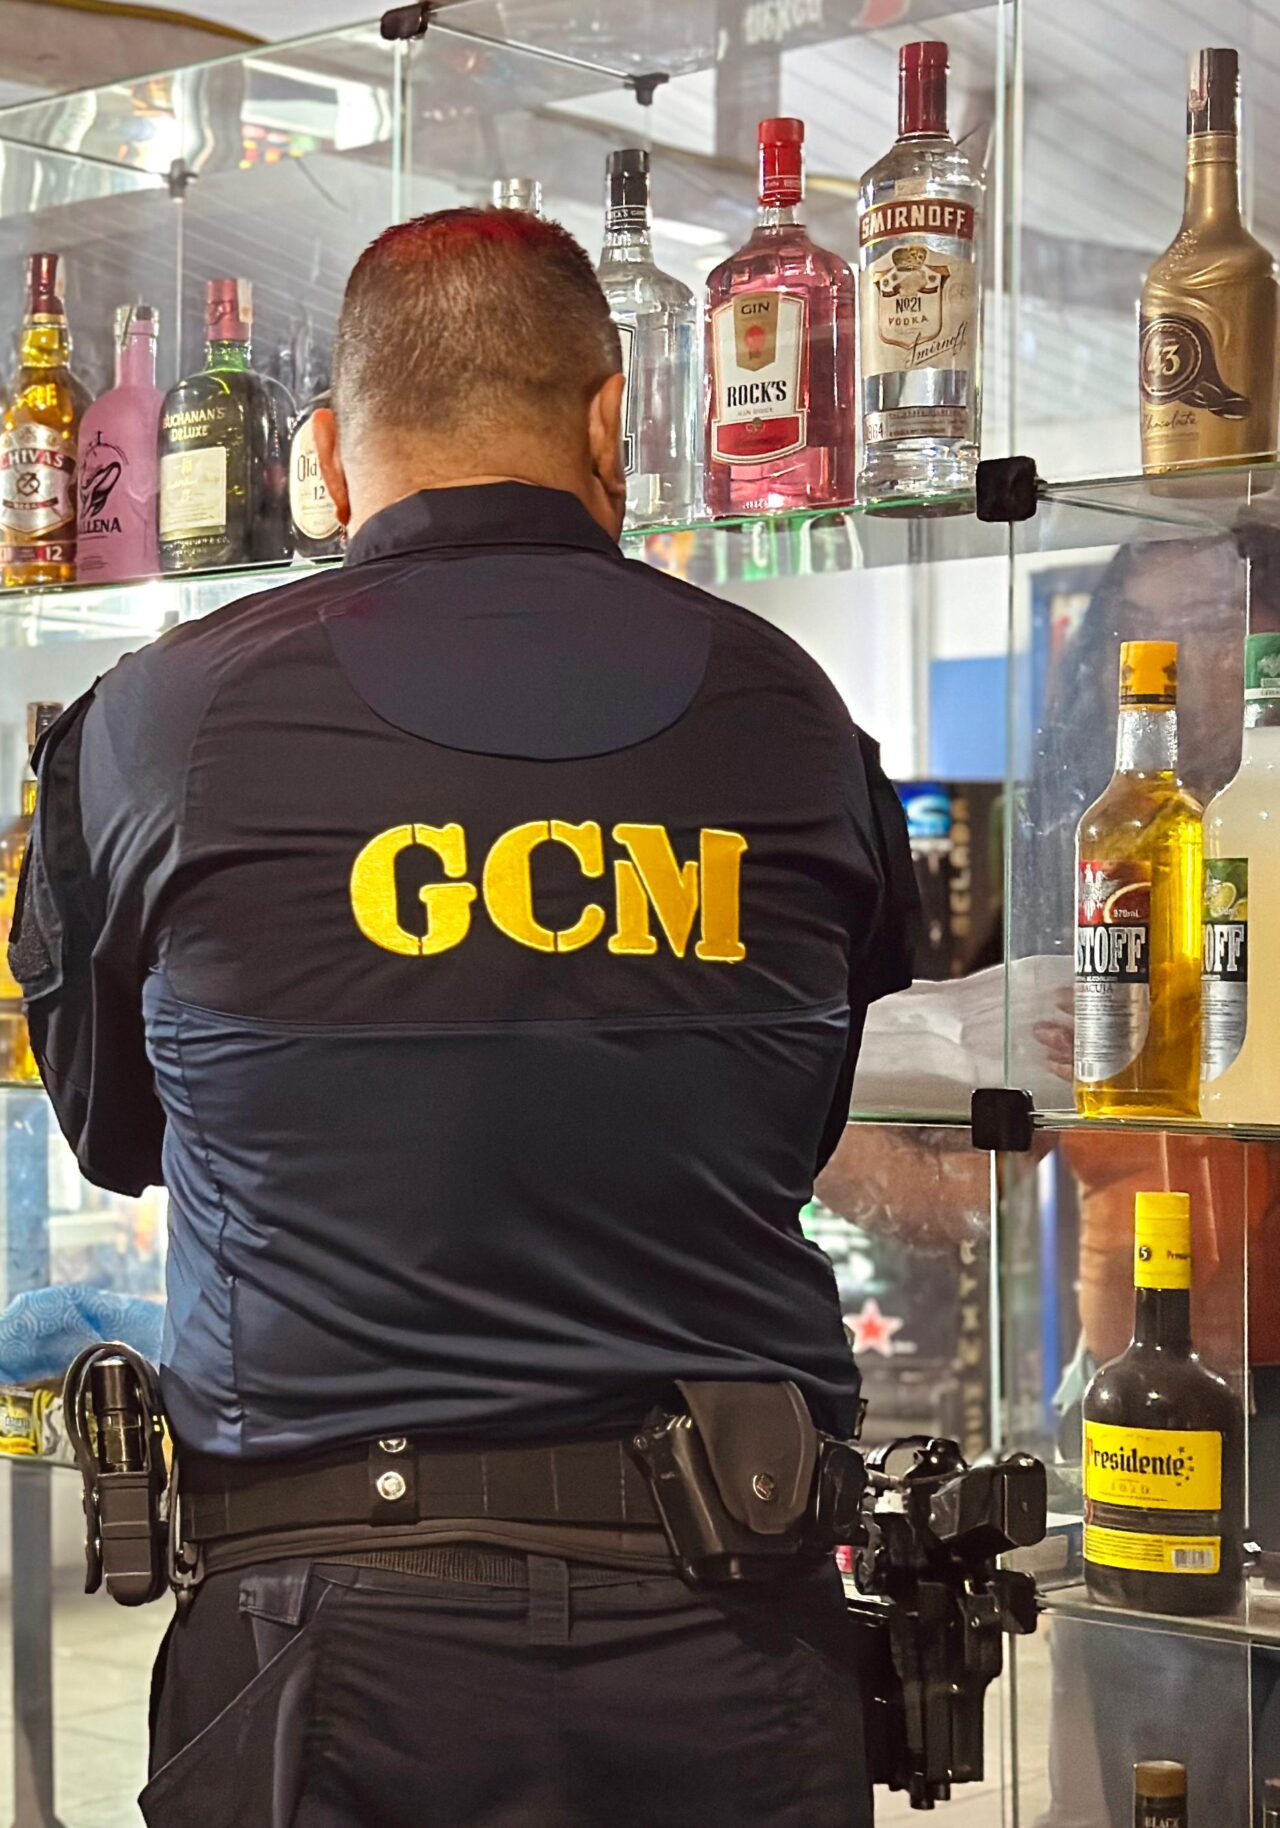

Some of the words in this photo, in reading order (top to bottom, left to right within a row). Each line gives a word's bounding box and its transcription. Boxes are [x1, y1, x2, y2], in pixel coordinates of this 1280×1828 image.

[861, 205, 966, 239] SMIRNOFF
[741, 302, 770, 315] GIN
[889, 315, 928, 326] VODKA
[906, 321, 969, 370] Smirnoff
[1147, 344, 1181, 377] 43
[727, 380, 787, 408] ROCK'S
[0, 448, 65, 468] CHIVAS
[297, 454, 317, 482] Old
[314, 485, 326, 500] 12
[46, 545, 64, 561] 12
[350, 819, 749, 965] GCM
